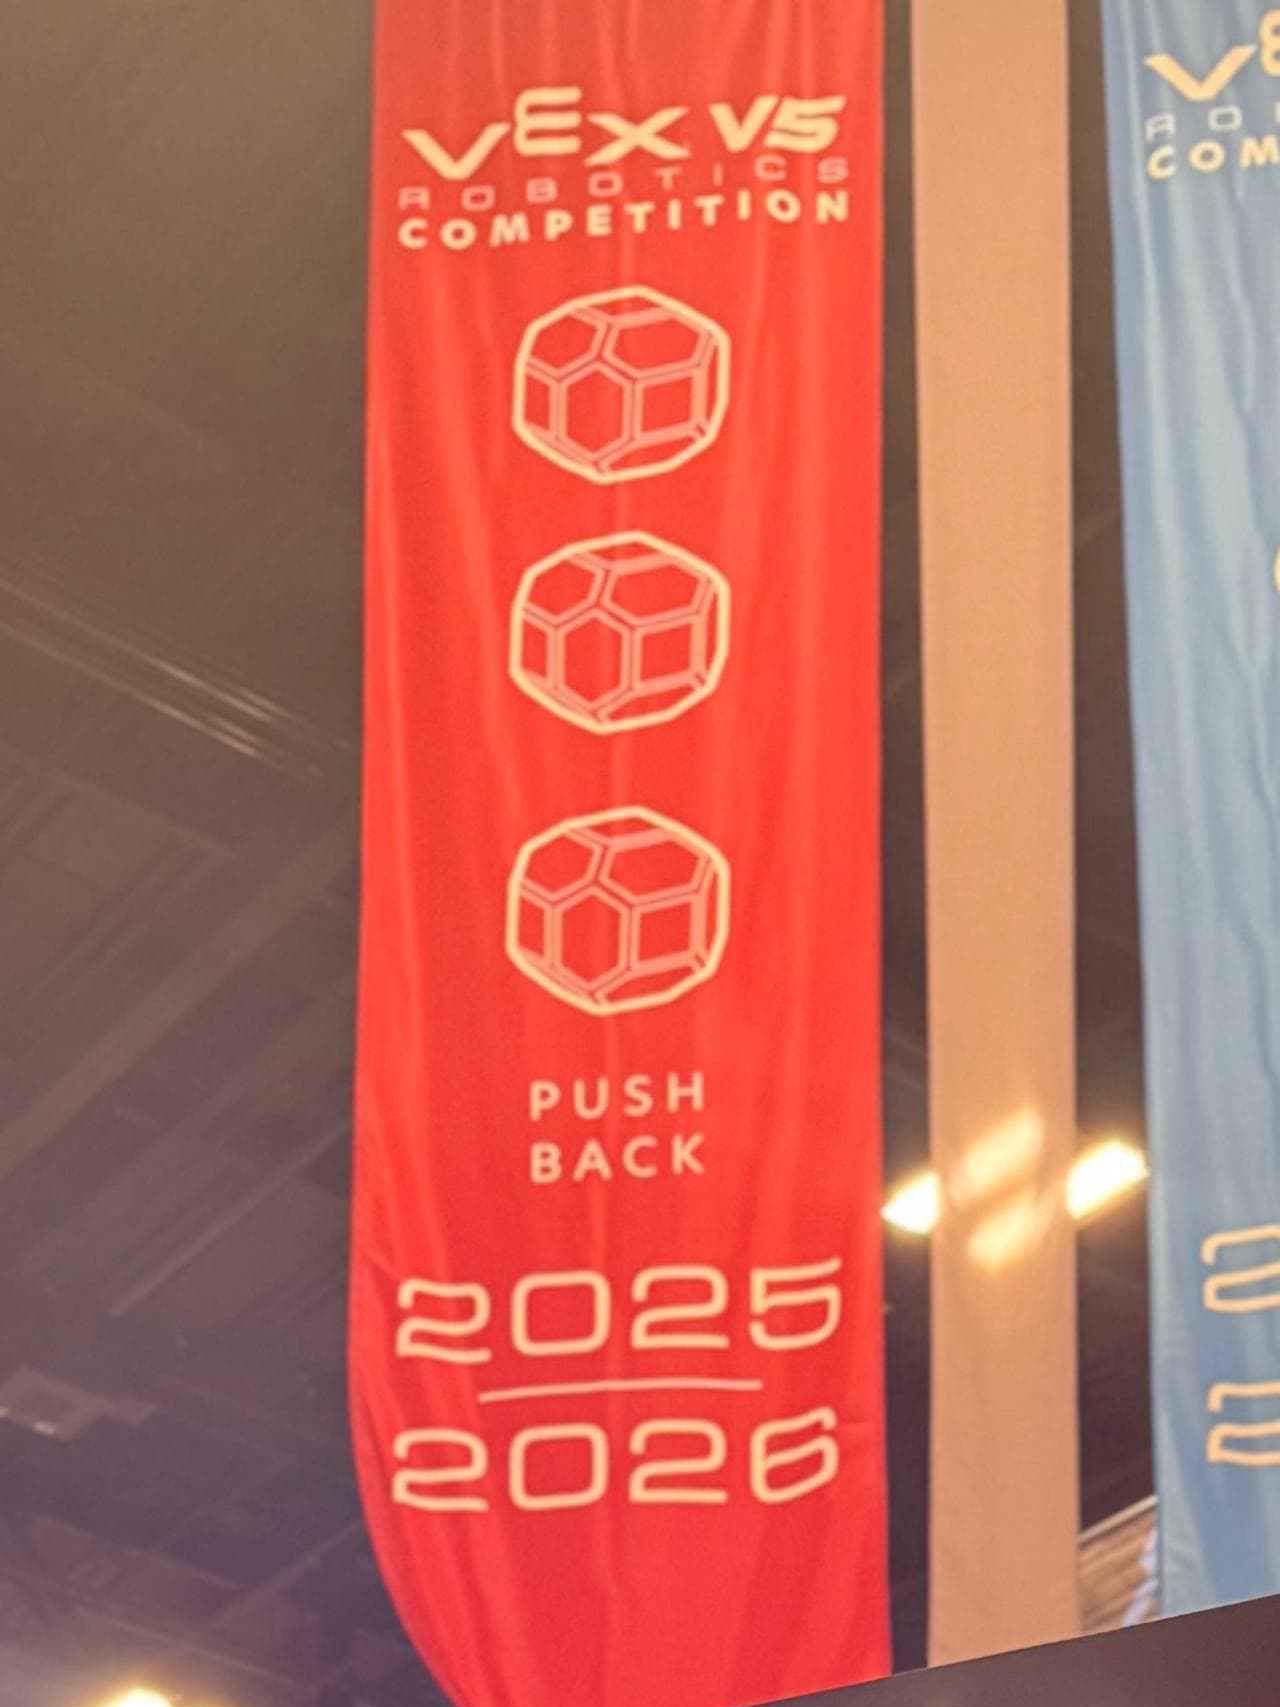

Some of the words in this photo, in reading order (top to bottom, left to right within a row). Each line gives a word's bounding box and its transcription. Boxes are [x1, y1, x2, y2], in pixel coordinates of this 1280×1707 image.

[402, 86, 691, 180] VEX
[709, 95, 847, 152] V5
[398, 155, 849, 211] ROBOTICS
[398, 190, 848, 249] COMPETITION
[529, 1071, 706, 1122] PUSH
[529, 1133, 706, 1184] BACK
[395, 1257, 842, 1365] 2025
[392, 1406, 839, 1513] 2026
